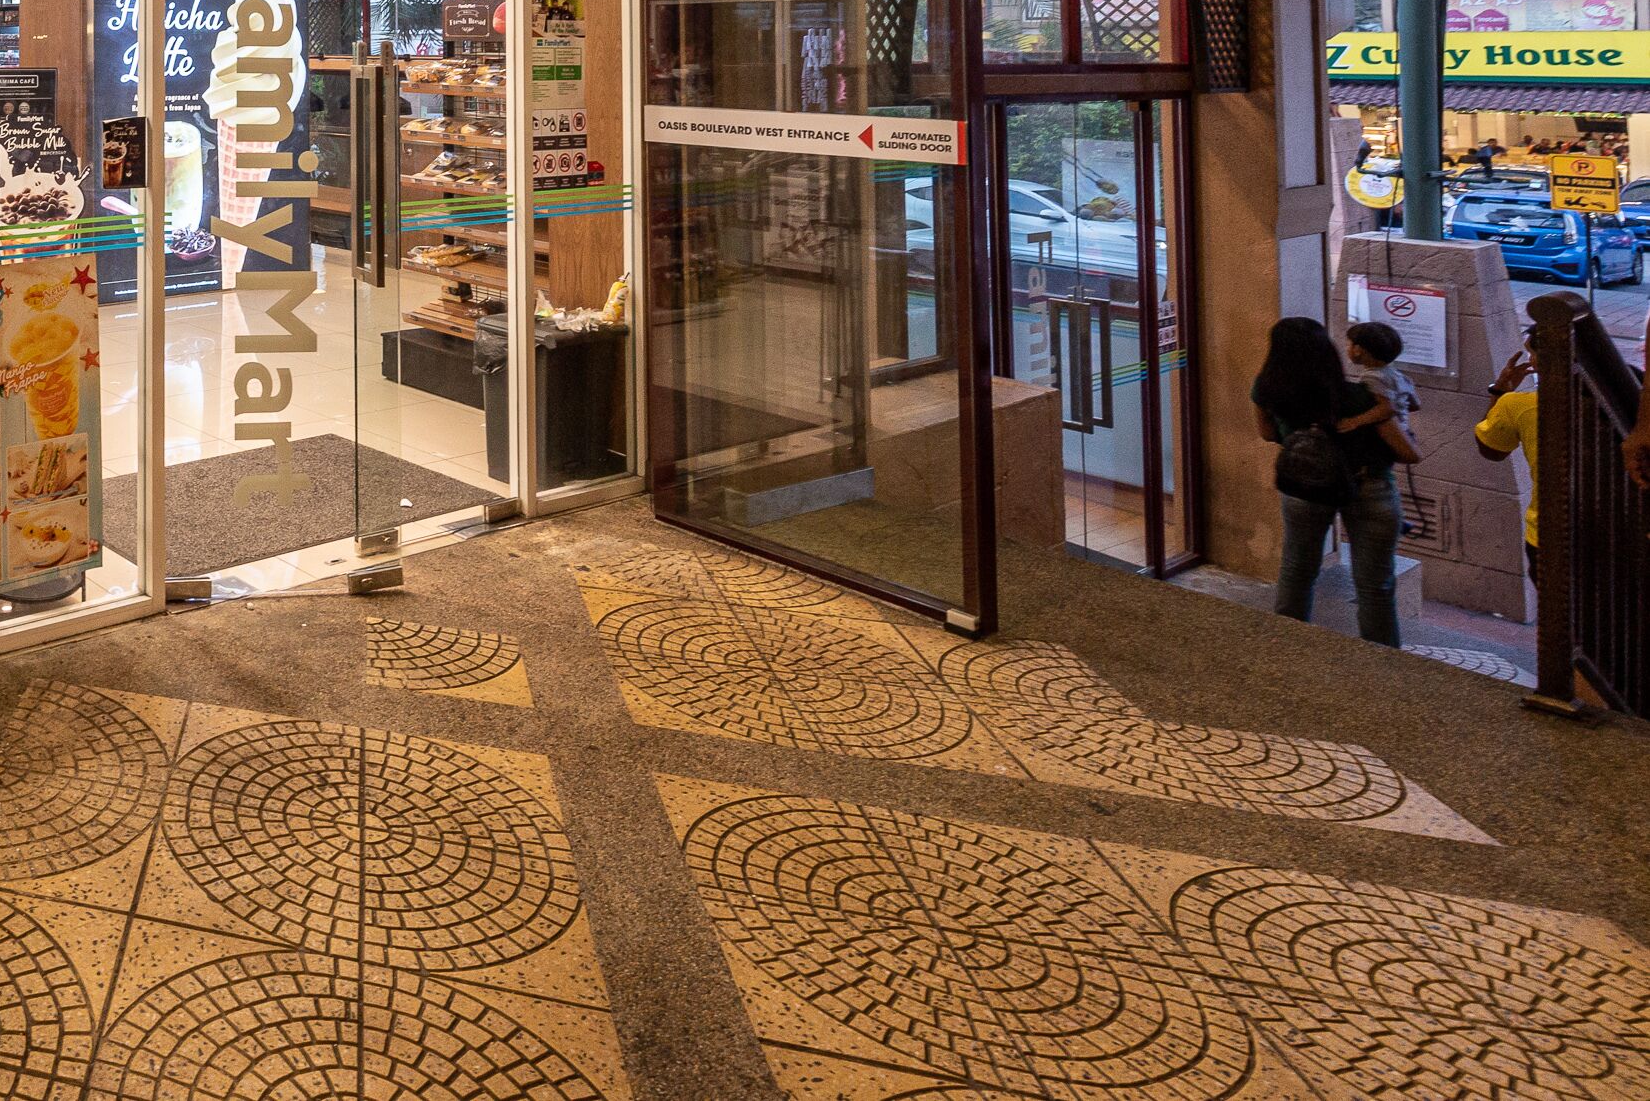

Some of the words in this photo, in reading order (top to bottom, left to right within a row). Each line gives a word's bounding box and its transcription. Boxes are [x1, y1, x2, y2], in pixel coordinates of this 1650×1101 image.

[449, 17, 467, 26] Fresh
[468, 17, 486, 26] Bread
[544, 39, 571, 47] FamilyMart
[120, 36, 195, 83] Ltte
[1326, 45, 1351, 70] Z
[1360, 44, 1471, 70] Cuy
[1483, 44, 1625, 67] House
[184, 104, 201, 113] Japan
[0, 122, 31, 138] Brown
[32, 122, 62, 138] Sugar
[657, 120, 688, 131] OASIS
[690, 122, 752, 137] BOULEVARD
[754, 126, 784, 138] WEST
[786, 128, 851, 143] ENTRANCE
[890, 130, 952, 144] AUTOMATED
[3, 136, 41, 152] Bubble
[42, 135, 67, 151] Milk
[877, 139, 918, 152] SLIDING
[919, 141, 952, 154] DOOR
[3, 369, 48, 399] Frappe
